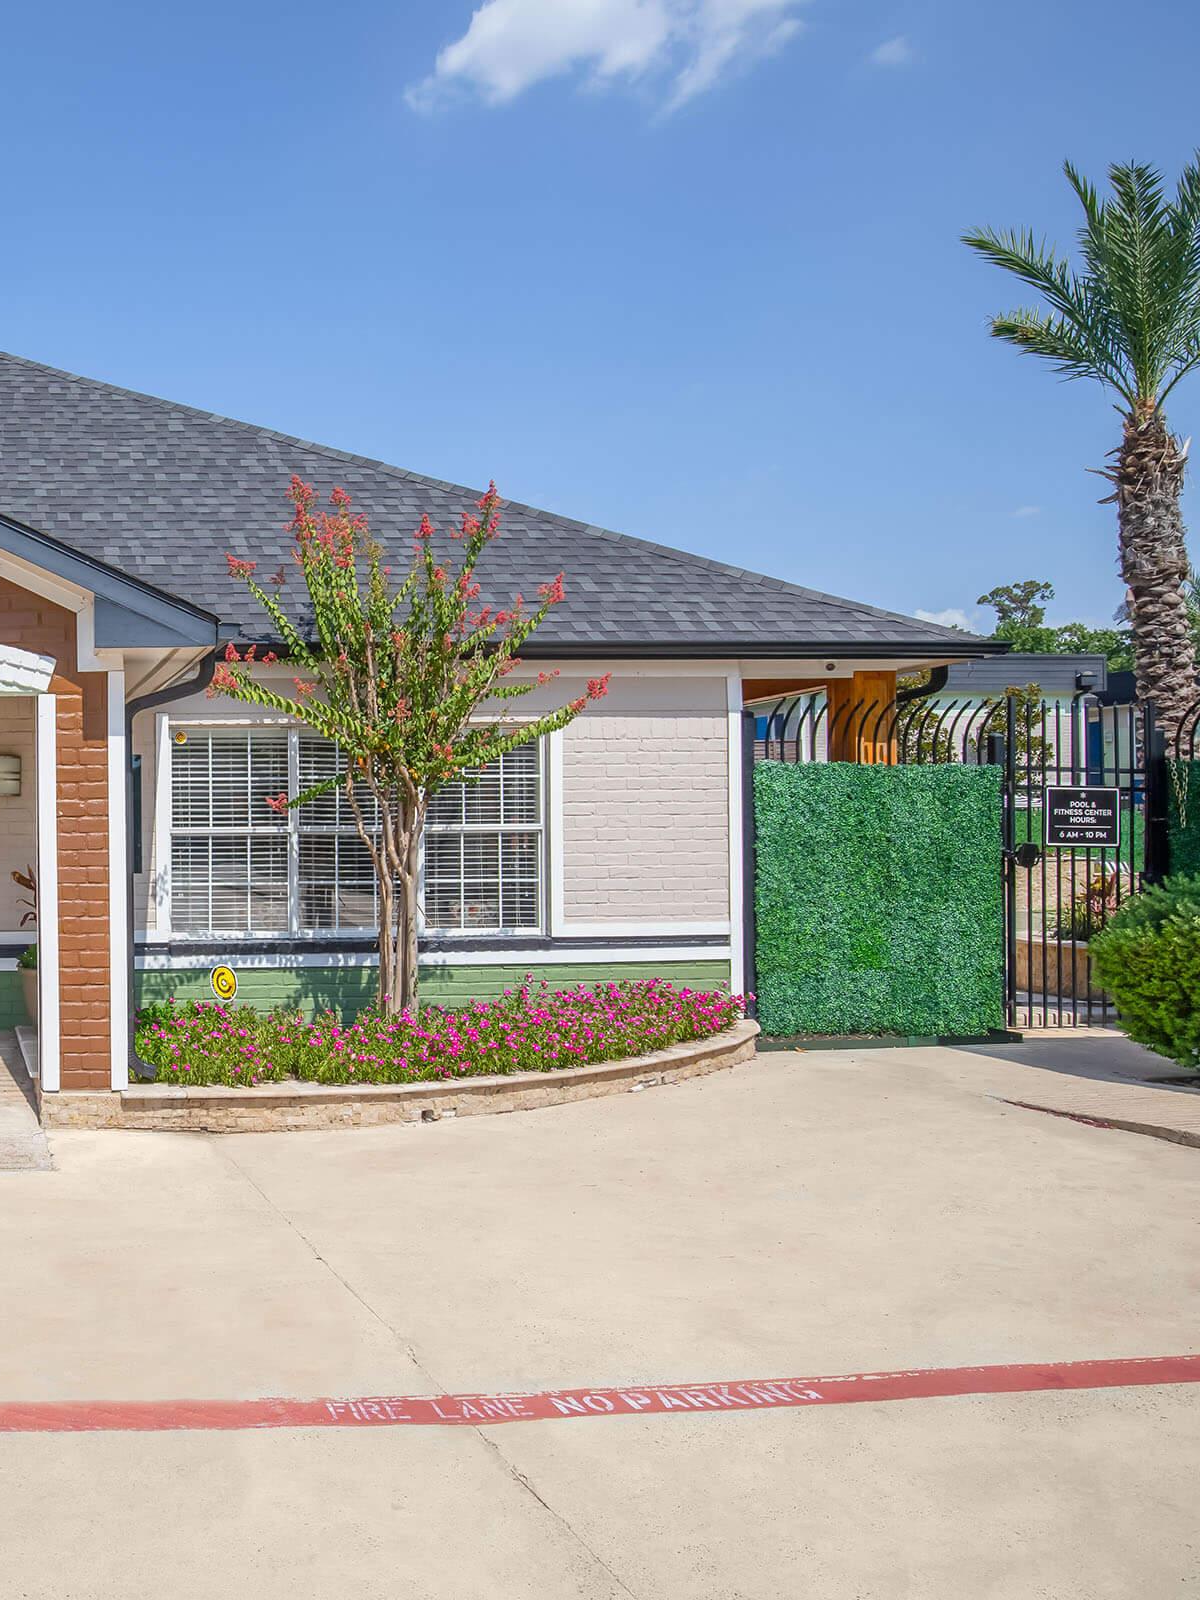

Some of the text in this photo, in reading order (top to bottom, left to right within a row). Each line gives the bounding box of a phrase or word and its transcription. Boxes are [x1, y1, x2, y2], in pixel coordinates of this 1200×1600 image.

[1054, 808, 1113, 817] FITNESS CENTER
[1069, 816, 1097, 824] HOURS:
[1095, 831, 1107, 839] PM
[325, 1383, 823, 1421] FIRE LANE NO PARKING
